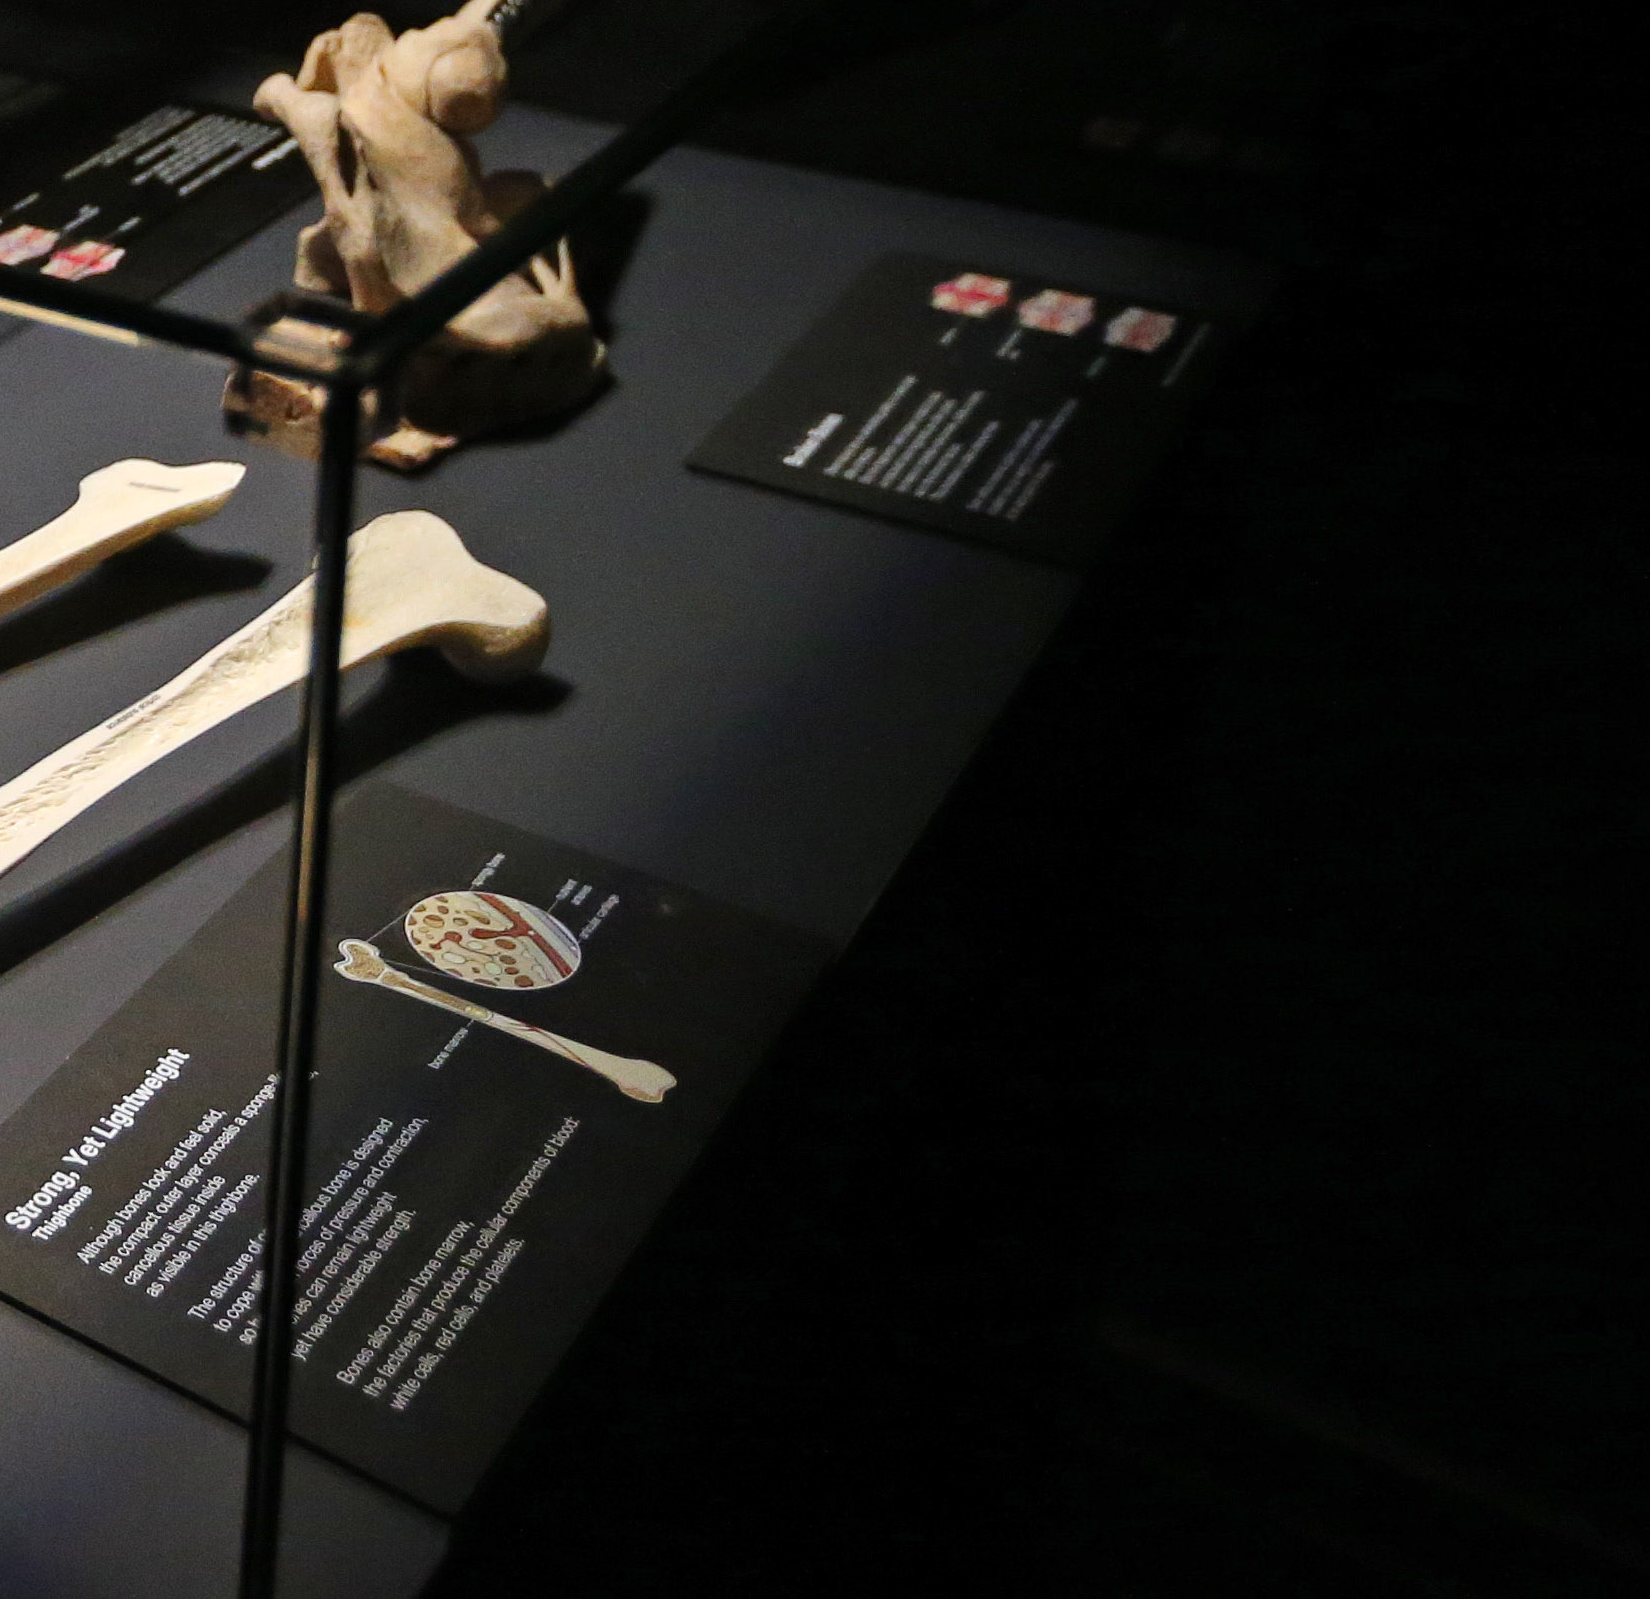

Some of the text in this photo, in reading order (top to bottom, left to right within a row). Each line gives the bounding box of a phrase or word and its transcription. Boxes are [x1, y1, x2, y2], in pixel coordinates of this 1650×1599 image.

[4, 1047, 190, 1230] Strong, Yet Lightweight
[31, 1185, 92, 1240] Thighbone
[76, 1108, 227, 1265] Although bones look and feel solid,
[97, 1255, 122, 1275] the
[116, 1210, 162, 1257] compact
[155, 1185, 183, 1213] outer
[173, 1162, 204, 1189] layer
[198, 1123, 241, 1165] conceals
[233, 1116, 248, 1126] a
[186, 1297, 216, 1319] The
[209, 1252, 253, 1299] structure
[247, 1238, 262, 1254] of
[320, 1168, 352, 1195] bone
[340, 1159, 360, 1170] is
[351, 1116, 393, 1160] designed
[123, 1175, 226, 1285] cancellous tissue inside
[145, 1173, 260, 1297] as visible in this thighbone.
[212, 1317, 232, 1332] to
[225, 1290, 255, 1319] cope
[319, 1224, 335, 1240] of
[328, 1186, 369, 1231] pressure
[362, 1165, 384, 1188] and
[377, 1117, 429, 1168] contraction,
[238, 1327, 257, 1345] so
[305, 1276, 329, 1298] can
[320, 1242, 356, 1279] remain
[344, 1190, 397, 1244] lightweight
[290, 1209, 416, 1362] yet have considerable strength.
[335, 1220, 475, 1385] Bones also contain bone marrow,
[361, 1115, 580, 1397] the factories that produce the cellular components of blood:
[389, 1238, 525, 1410] white cells, red cells, and platelets.
